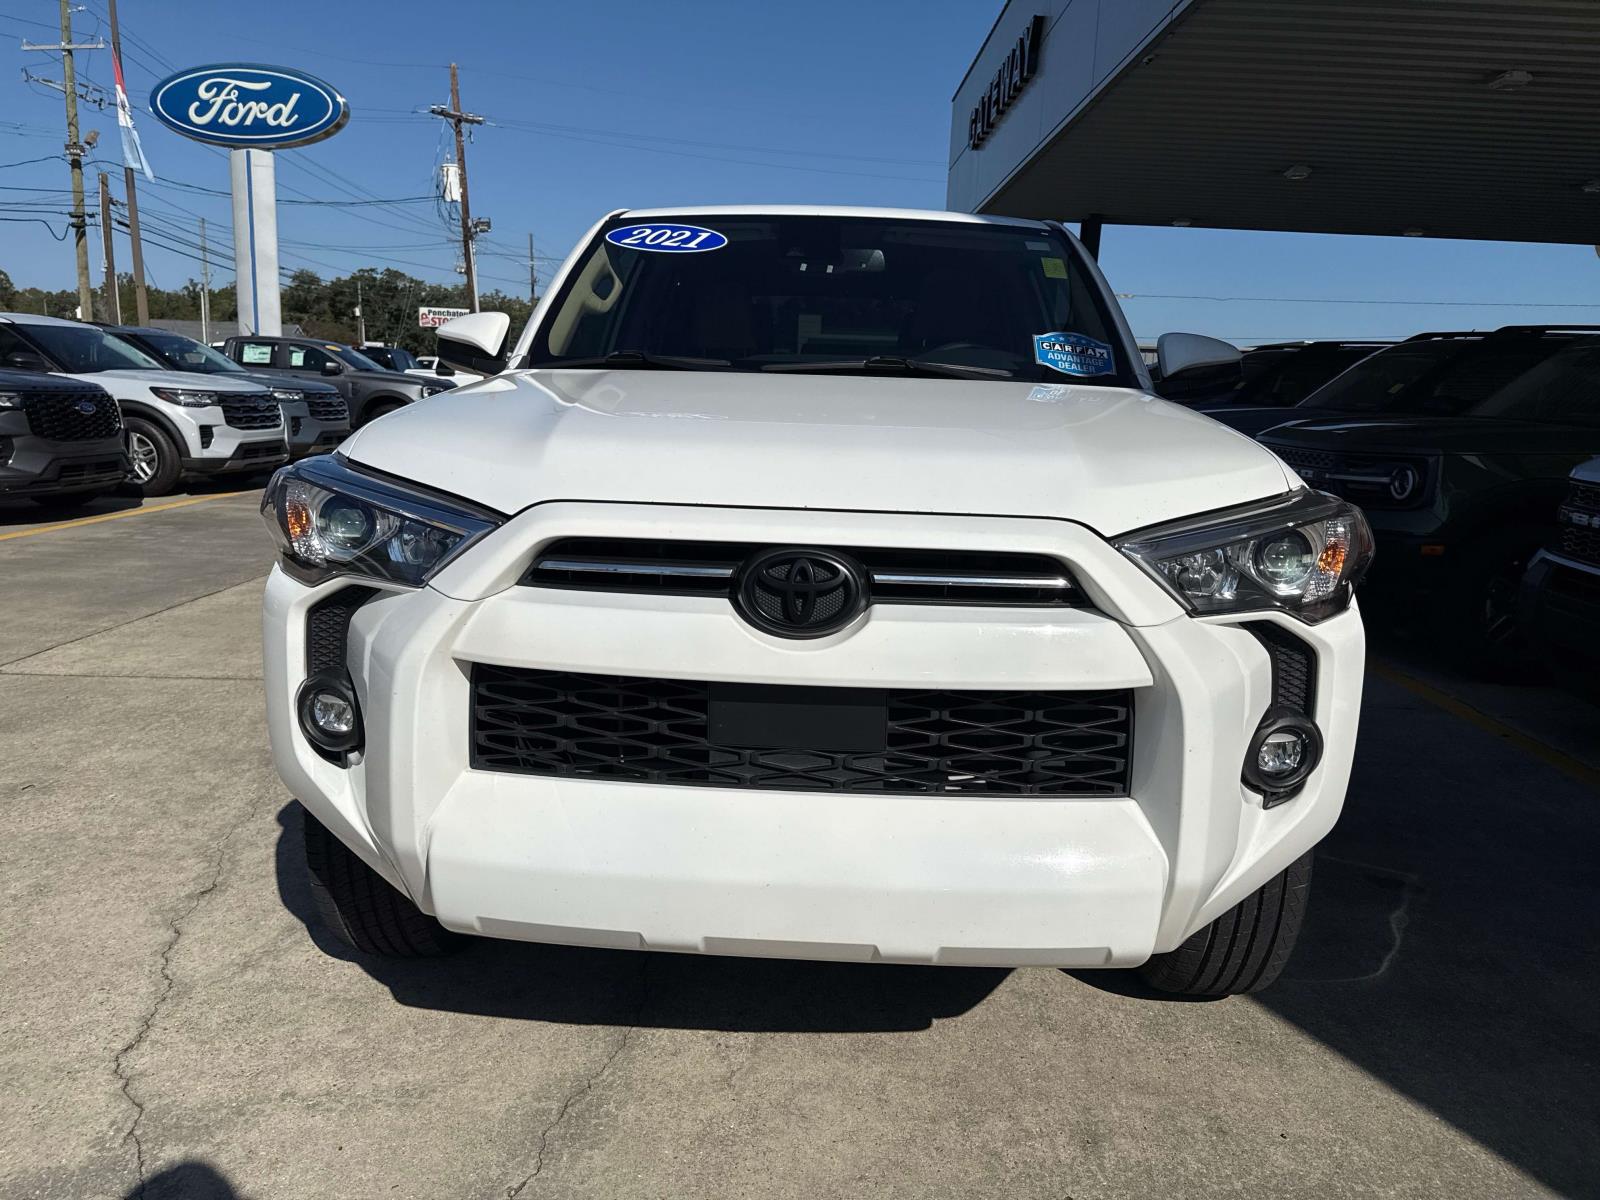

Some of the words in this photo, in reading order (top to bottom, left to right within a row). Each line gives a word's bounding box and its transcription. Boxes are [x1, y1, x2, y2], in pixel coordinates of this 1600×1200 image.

[968, 15, 1045, 151] GATEWAY
[188, 78, 300, 127] Ford
[620, 228, 711, 249] 2021
[1041, 341, 1109, 359] CARFAX
[1047, 352, 1105, 367] ADVANTAGE
[1058, 361, 1096, 373] DEALER
